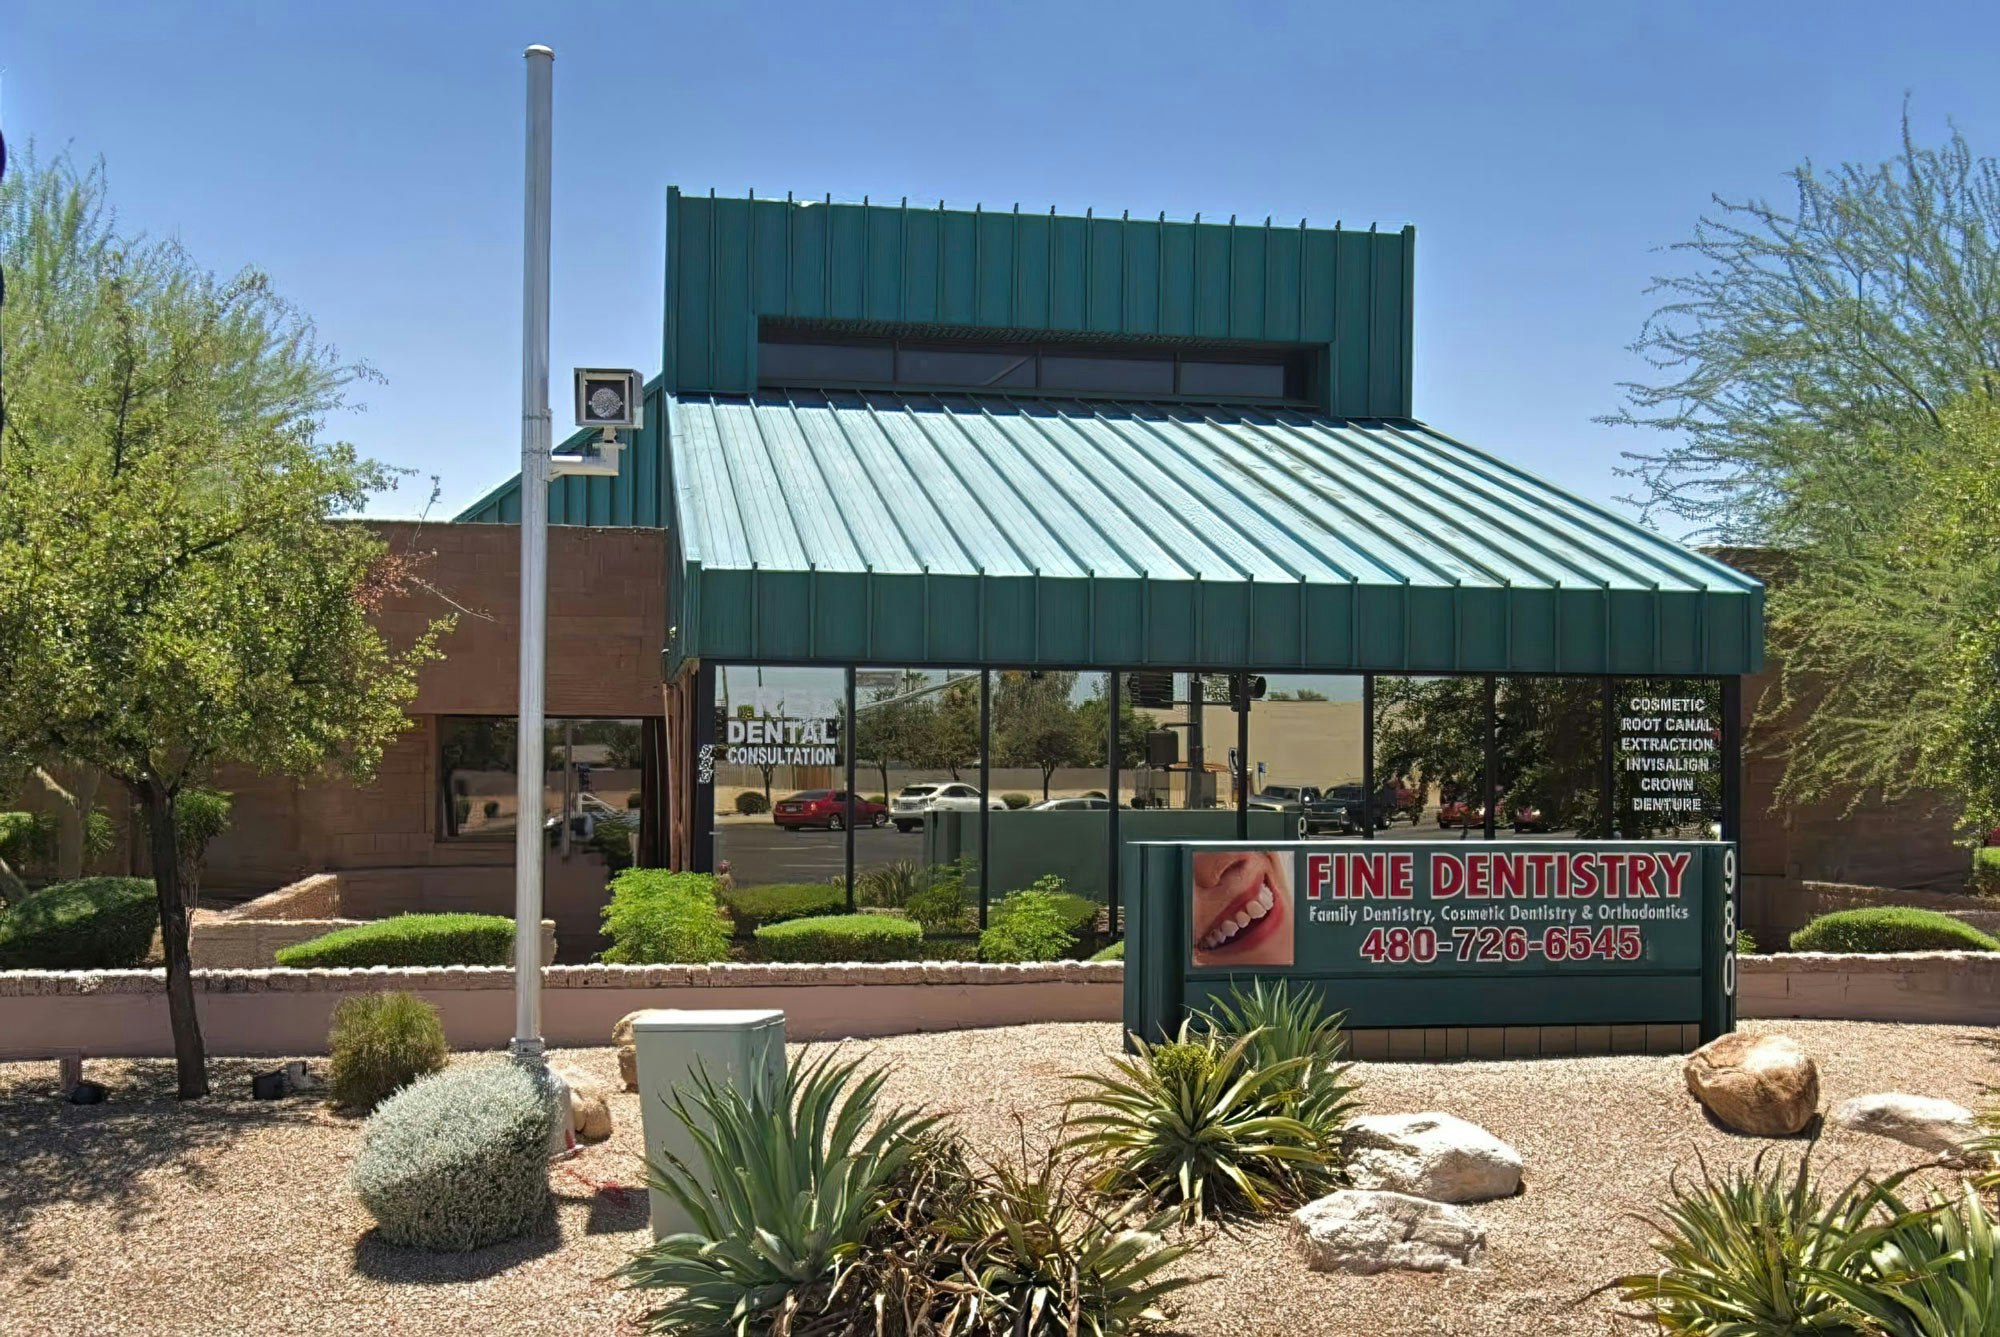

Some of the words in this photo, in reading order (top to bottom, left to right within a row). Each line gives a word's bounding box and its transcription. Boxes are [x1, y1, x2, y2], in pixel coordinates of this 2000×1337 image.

[1630, 698, 1706, 711] COSMETIC
[1621, 717, 1661, 731] ROOT
[1665, 717, 1713, 731] CANAL
[727, 720, 836, 744] DENTAL
[1621, 737, 1713, 751] EXTRACTION
[727, 746, 836, 765] CONSULTATION
[1626, 758, 1709, 771] INVISALIGN
[1641, 777, 1694, 791] CROWN
[1632, 798, 1701, 811] DENTURE
[1307, 852, 1414, 900] FINE
[1431, 852, 1691, 898] DENTISTRY
[1309, 905, 1357, 926] Family
[1363, 905, 1435, 925] Dentistry,
[1441, 904, 1504, 922] Cosmetic
[1510, 904, 1577, 924] Dentistry
[1581, 904, 1593, 920] &
[1599, 903, 1689, 920] Orthodontics
[1360, 925, 1642, 963] 480-726-6545
